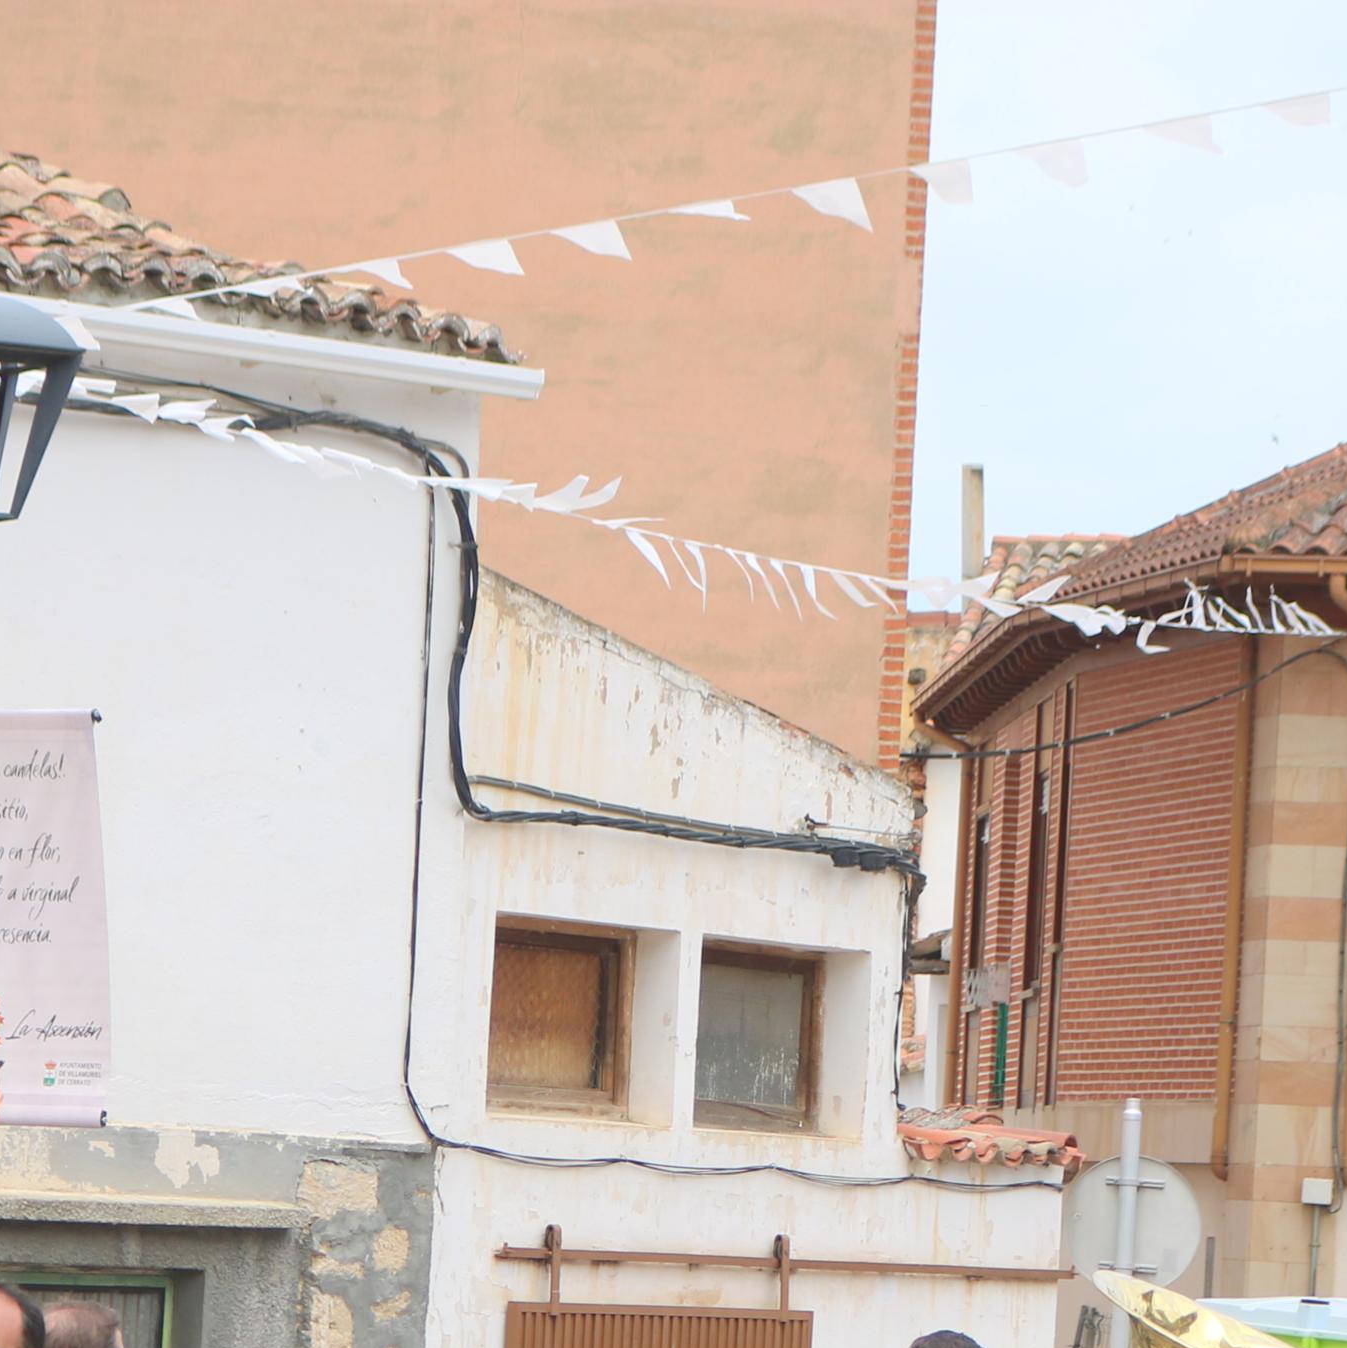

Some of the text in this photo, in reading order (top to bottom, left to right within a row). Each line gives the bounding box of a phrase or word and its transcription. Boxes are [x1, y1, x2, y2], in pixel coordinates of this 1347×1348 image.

[8, 847, 22, 861] en
[7, 887, 17, 900] a
[22, 875, 80, 920] virginal
[5, 1009, 36, 1041] La
